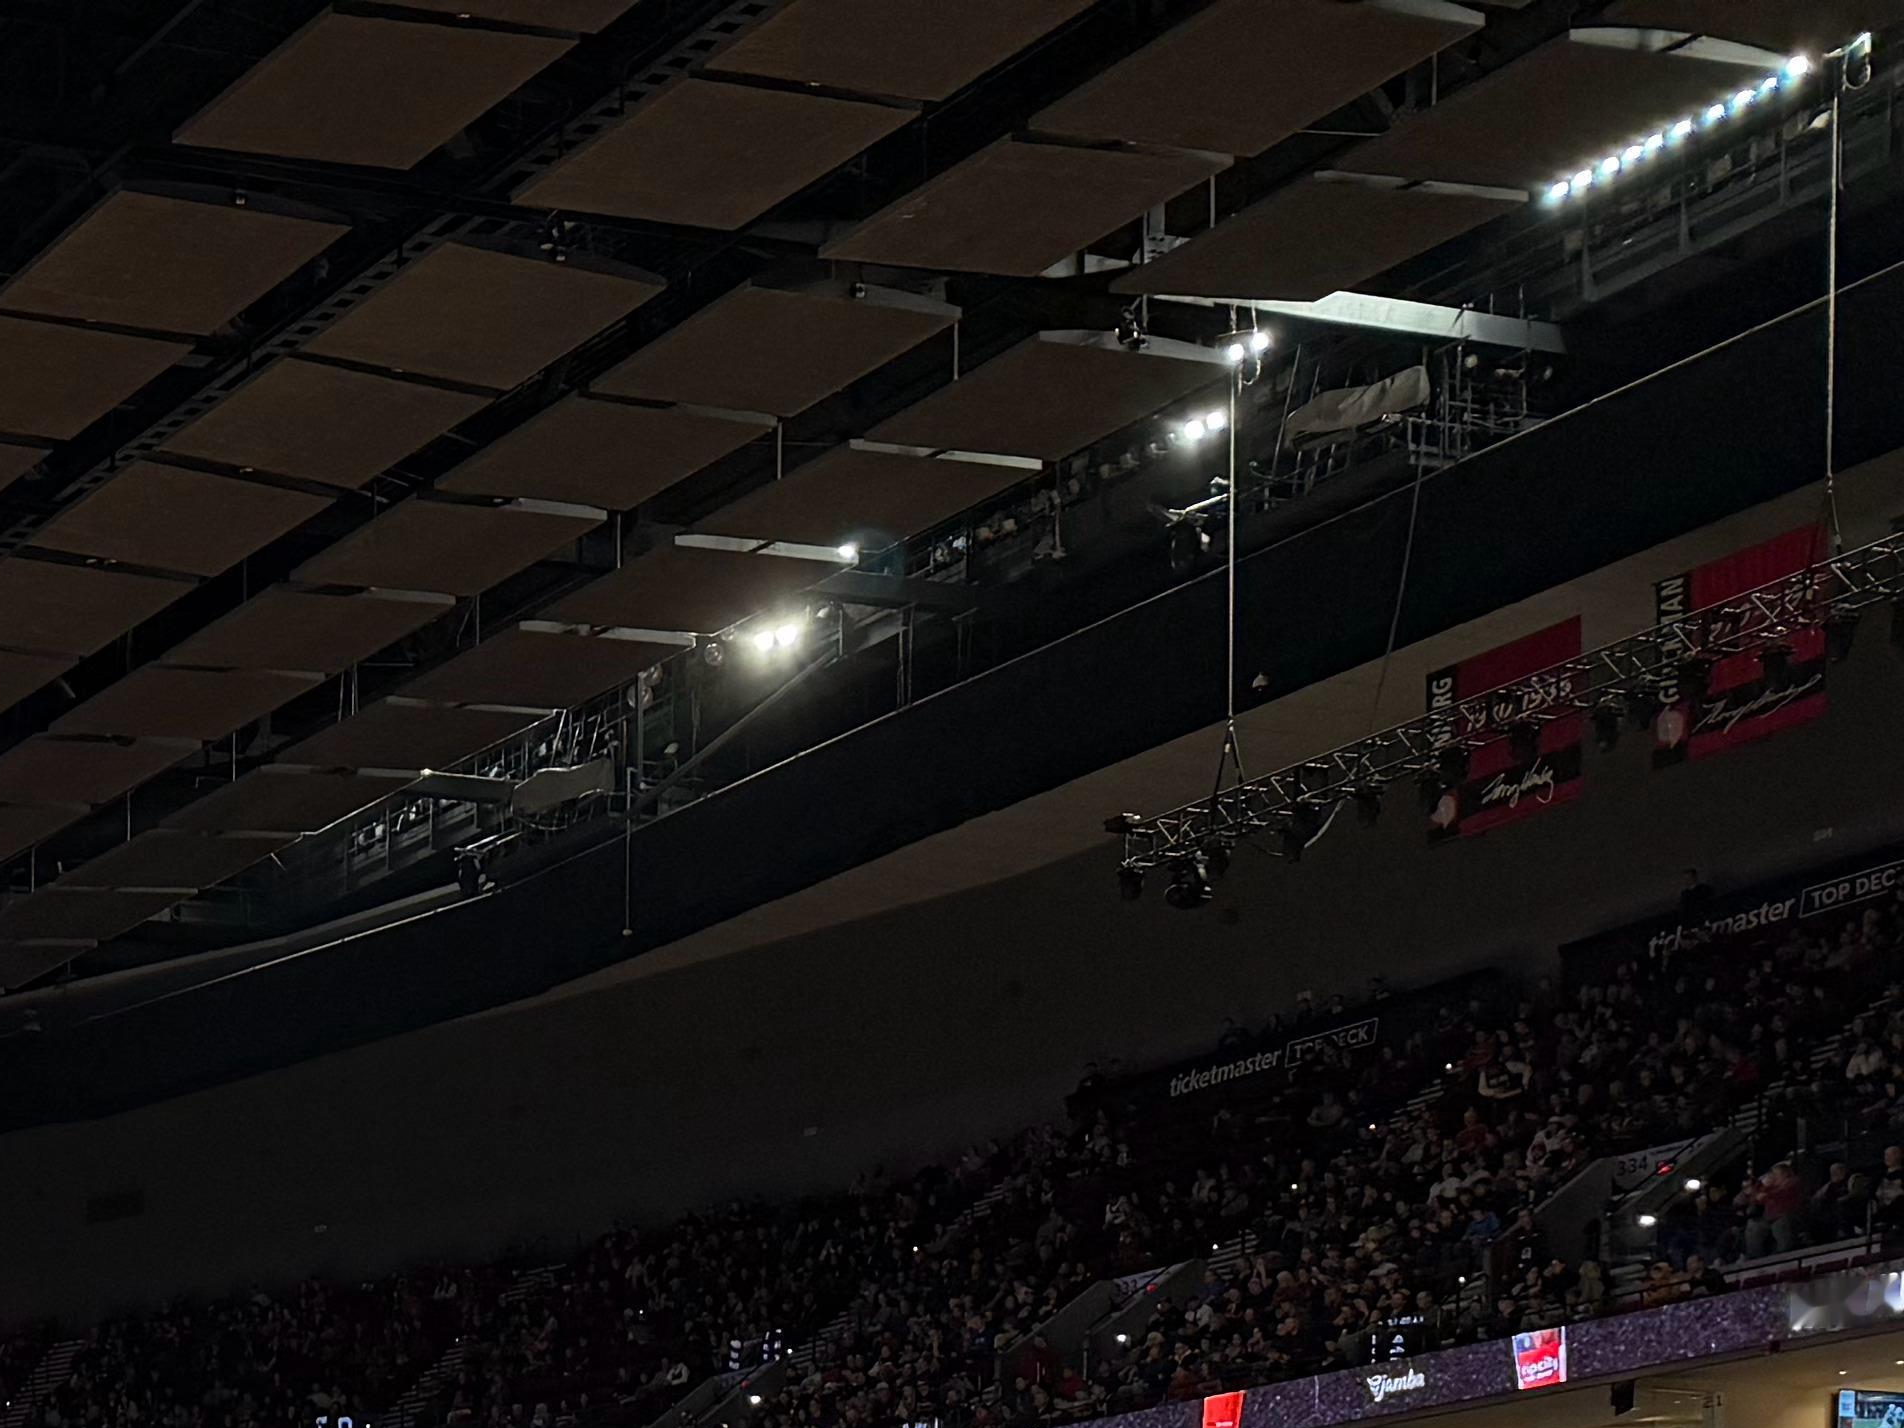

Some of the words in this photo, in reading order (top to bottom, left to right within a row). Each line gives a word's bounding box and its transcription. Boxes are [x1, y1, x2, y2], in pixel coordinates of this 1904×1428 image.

[1810, 882, 1849, 909] TOP
[1168, 1047, 1281, 1099] ticketmaster
[1378, 1369, 1425, 1396] jamba
